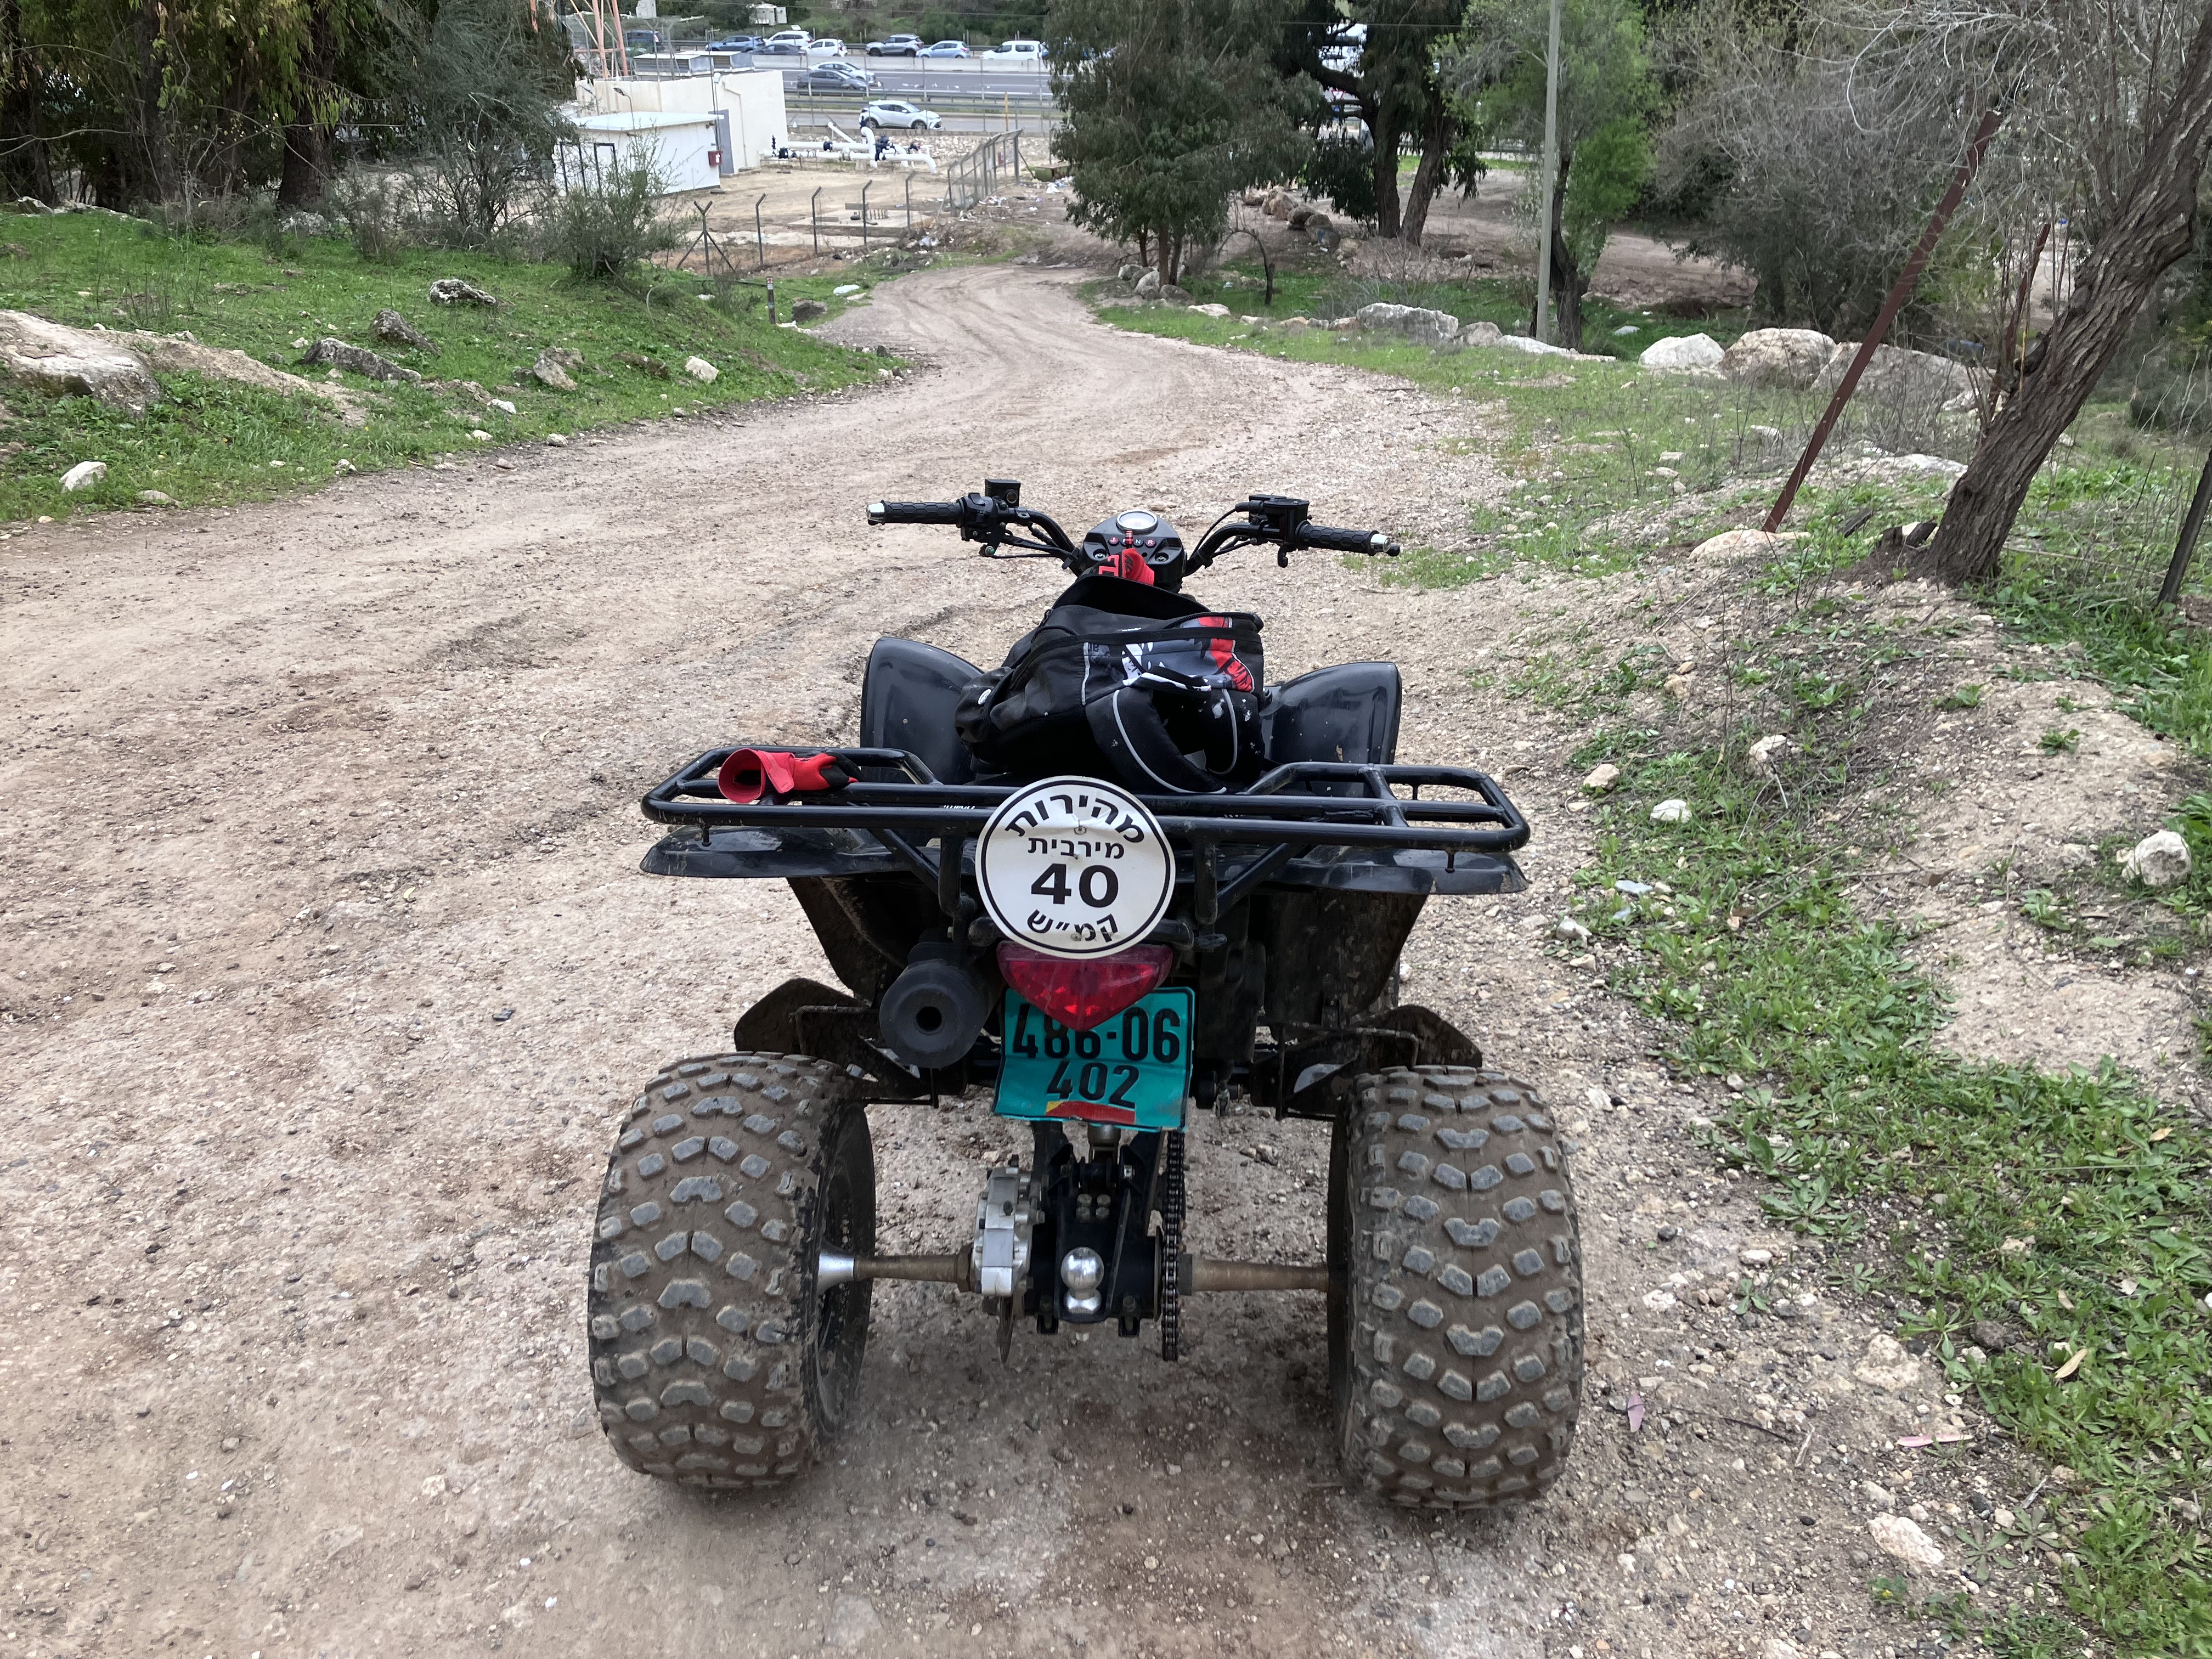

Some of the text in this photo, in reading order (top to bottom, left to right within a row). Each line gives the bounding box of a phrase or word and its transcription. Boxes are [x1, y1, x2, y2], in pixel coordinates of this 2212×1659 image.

[1004, 794, 1144, 843] מהירות
[1028, 837, 1124, 859] מירבית
[1031, 863, 1119, 908] 40
[1047, 1060, 1139, 1109] 402
